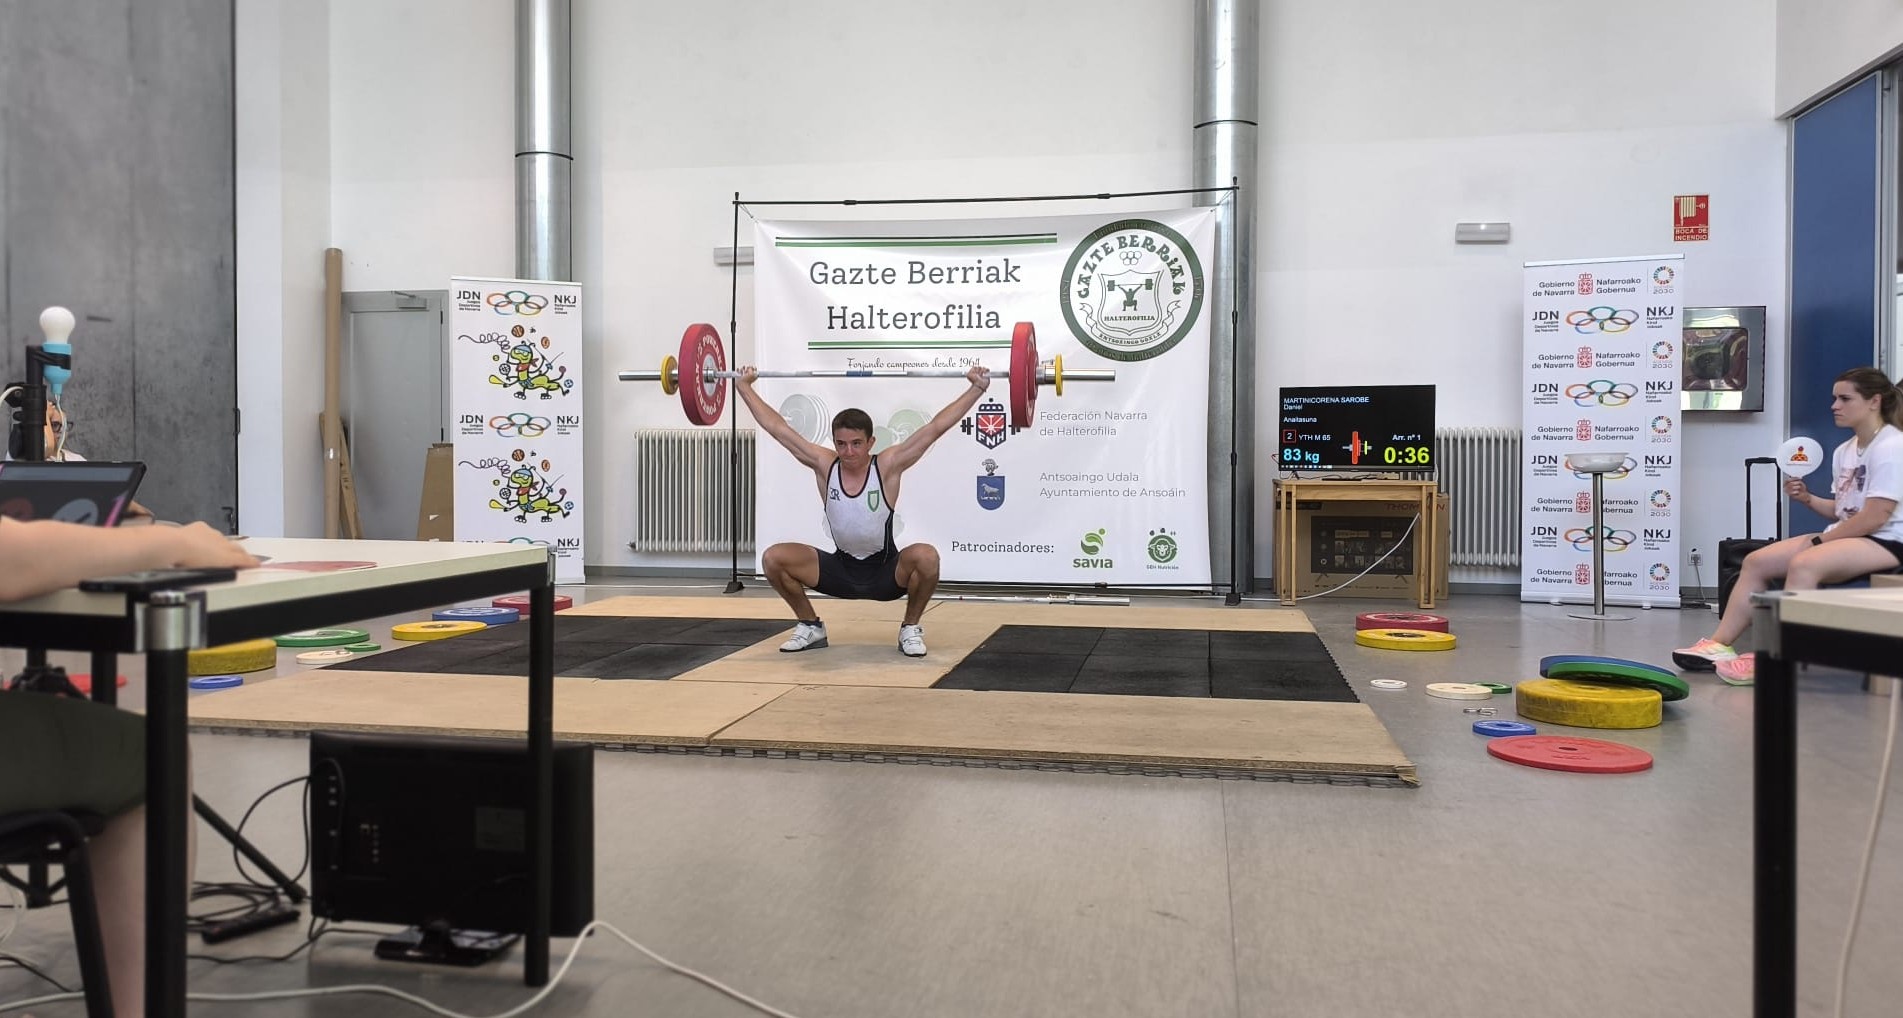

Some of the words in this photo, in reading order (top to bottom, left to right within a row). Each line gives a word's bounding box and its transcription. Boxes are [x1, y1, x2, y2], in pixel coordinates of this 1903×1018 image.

[810, 261, 897, 285] Gazte
[907, 258, 1021, 285] Berriak
[1077, 242, 1115, 299] GAZTE
[1538, 280, 1575, 289] Gobierno
[1596, 277, 1641, 286] Nafarroako
[456, 290, 481, 300] JDN
[1544, 289, 1575, 297] Navarra
[1596, 286, 1636, 294] Gobernua
[554, 294, 577, 304] NKJ
[1532, 311, 1559, 321] JDN
[1646, 306, 1674, 316] NKJ
[827, 304, 1001, 330] Halterofilia
[1595, 360, 1635, 368] Gobernua
[1532, 383, 1559, 393] JDN
[1645, 381, 1673, 391] NKJ
[459, 414, 484, 424] JDN
[557, 415, 579, 424] NKJ
[1040, 411, 1101, 421] Federación
[1104, 411, 1148, 420] Navarra
[1039, 427, 1054, 436] de
[1057, 426, 1117, 436] Halterofilia
[1286, 432, 1293, 440] 2
[978, 431, 1005, 447] FNH
[1594, 433, 1634, 441] Gobernua
[1283, 448, 1302, 461] 83
[1305, 451, 1320, 464] kg
[1384, 446, 1430, 464] 0:36
[1531, 455, 1558, 465] JDN
[1644, 455, 1672, 465] NKJ
[1040, 472, 1104, 484] Antsoaingo
[1106, 472, 1139, 482] Udala
[1040, 488, 1120, 499] Ayuntamiento
[1122, 488, 1137, 497] de
[1139, 487, 1186, 497] Ansoáin
[1537, 497, 1573, 505] Gobierno
[1602, 498, 1639, 506] farroako
[1384, 503, 1446, 511] THOMN
[1602, 506, 1633, 514] bernua
[1530, 526, 1557, 536] JDN
[1643, 528, 1671, 539] NKJ
[557, 538, 580, 547] NKJ
[951, 540, 1055, 553] Patrocinadores:
[1073, 557, 1113, 569] savia
[1536, 568, 1573, 576] Gobierno
[1604, 571, 1638, 579] farroako
